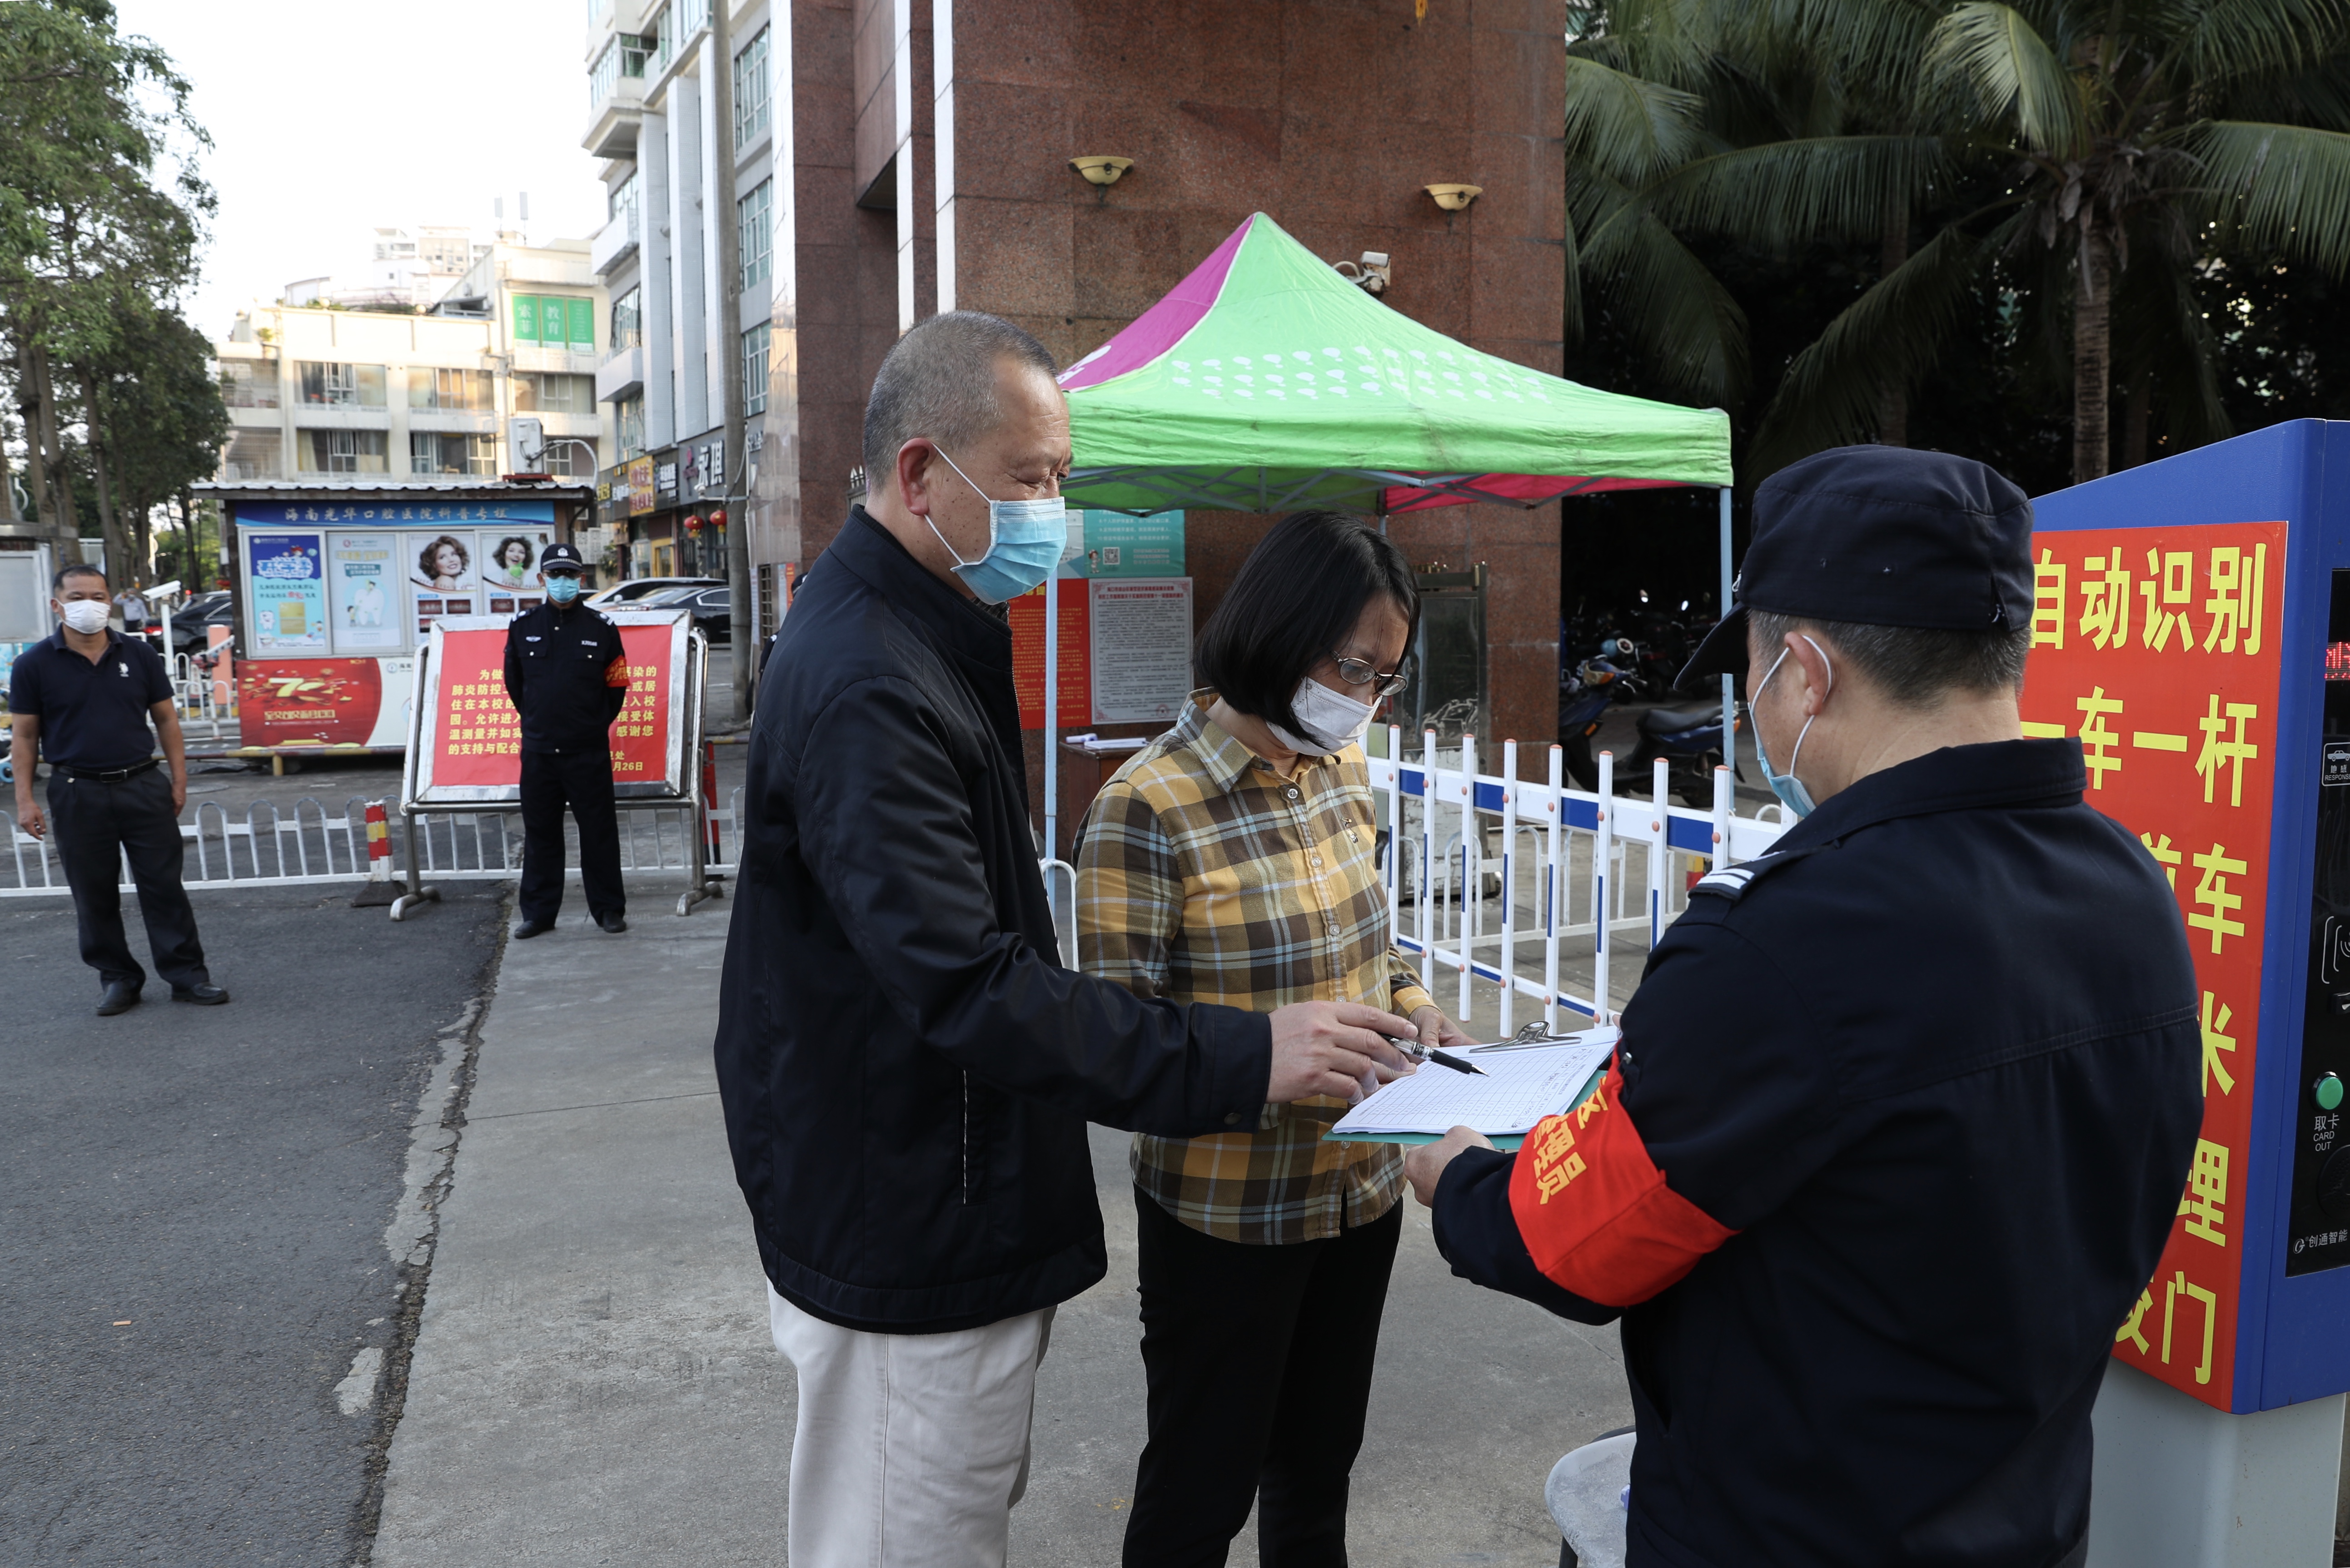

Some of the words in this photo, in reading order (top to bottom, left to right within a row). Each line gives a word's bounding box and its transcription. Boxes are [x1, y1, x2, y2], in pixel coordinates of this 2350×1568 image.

[2029, 543, 2266, 655] 自动识别
[479, 668, 503, 680] 为做
[617, 710, 655, 722] 接受体
[448, 726, 523, 740] 温测量并如实
[616, 724, 654, 737] 感谢您
[448, 741, 520, 755] 的支持与配合
[2019, 685, 2258, 807] 一车一杆
[612, 761, 643, 772] 月26日
[2314, 1113, 2340, 1131] 取卡
[2313, 1131, 2335, 1142] CARD
[2315, 1141, 2331, 1151] OUT
[2308, 1229, 2348, 1248] 创通智能
